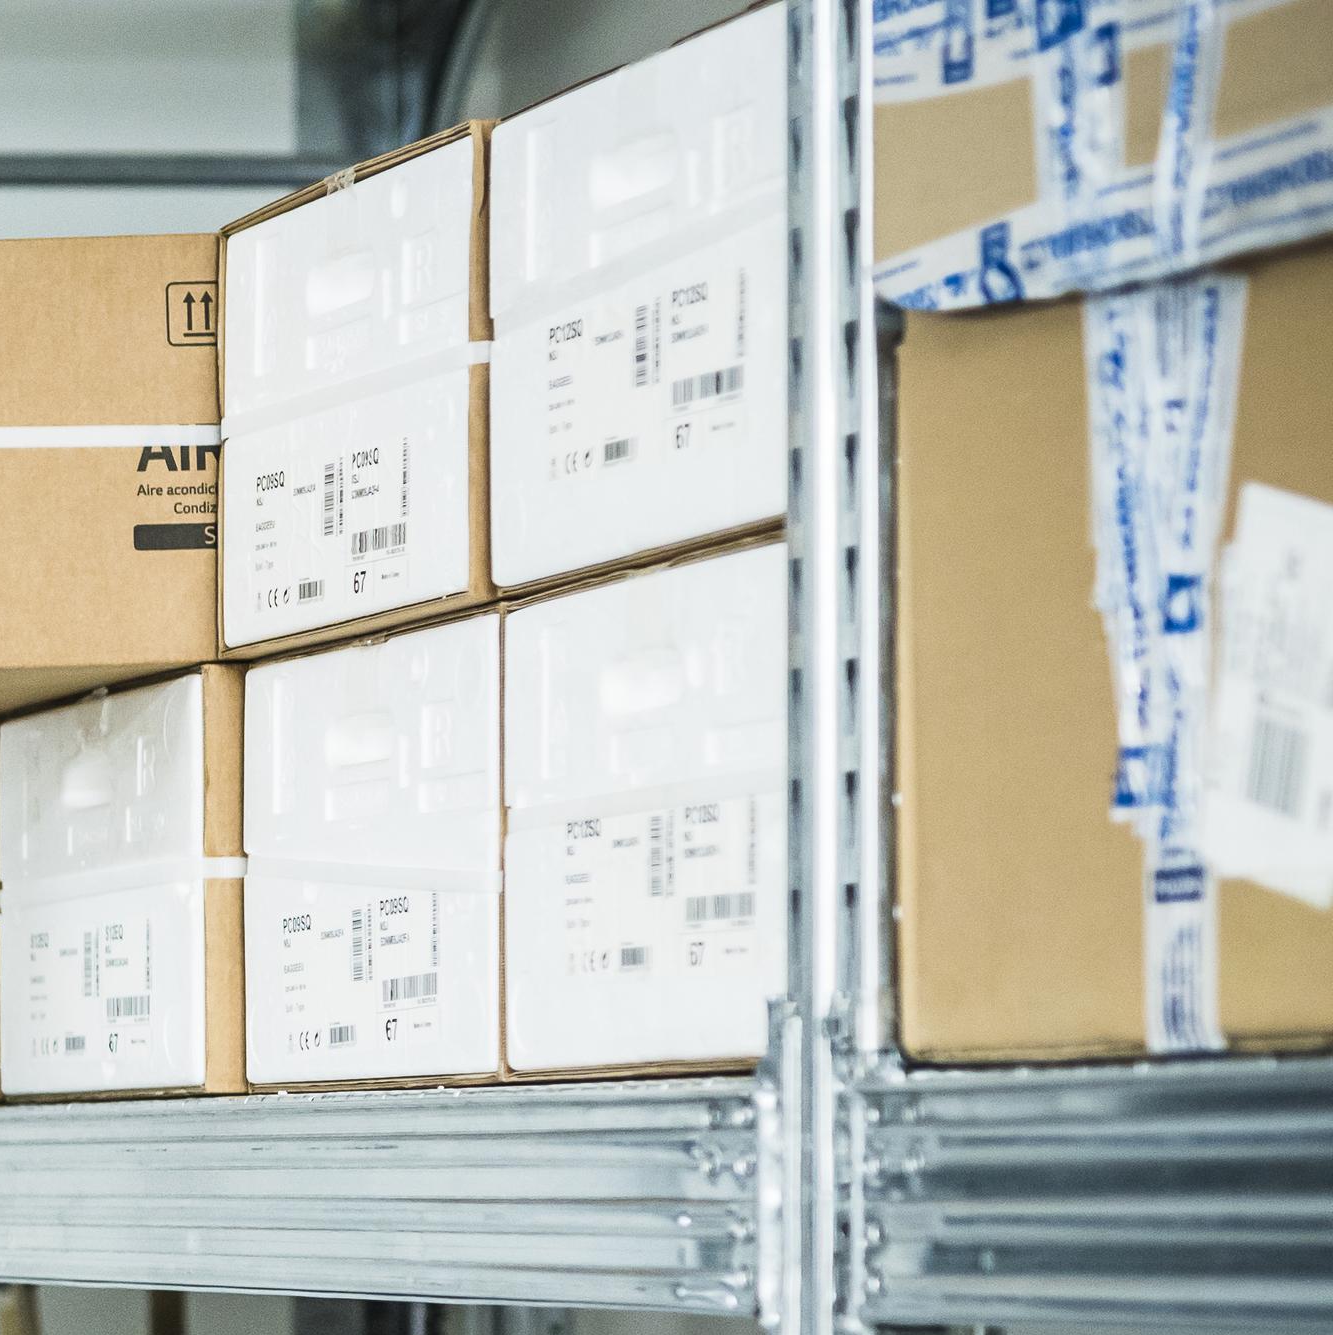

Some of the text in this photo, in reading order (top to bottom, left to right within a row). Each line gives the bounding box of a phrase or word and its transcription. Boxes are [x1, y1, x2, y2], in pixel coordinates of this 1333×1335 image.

[137, 484, 164, 496] Aire
[256, 470, 285, 493] PC09SQ
[353, 570, 367, 594] 67
[282, 913, 312, 934] PC09SQ
